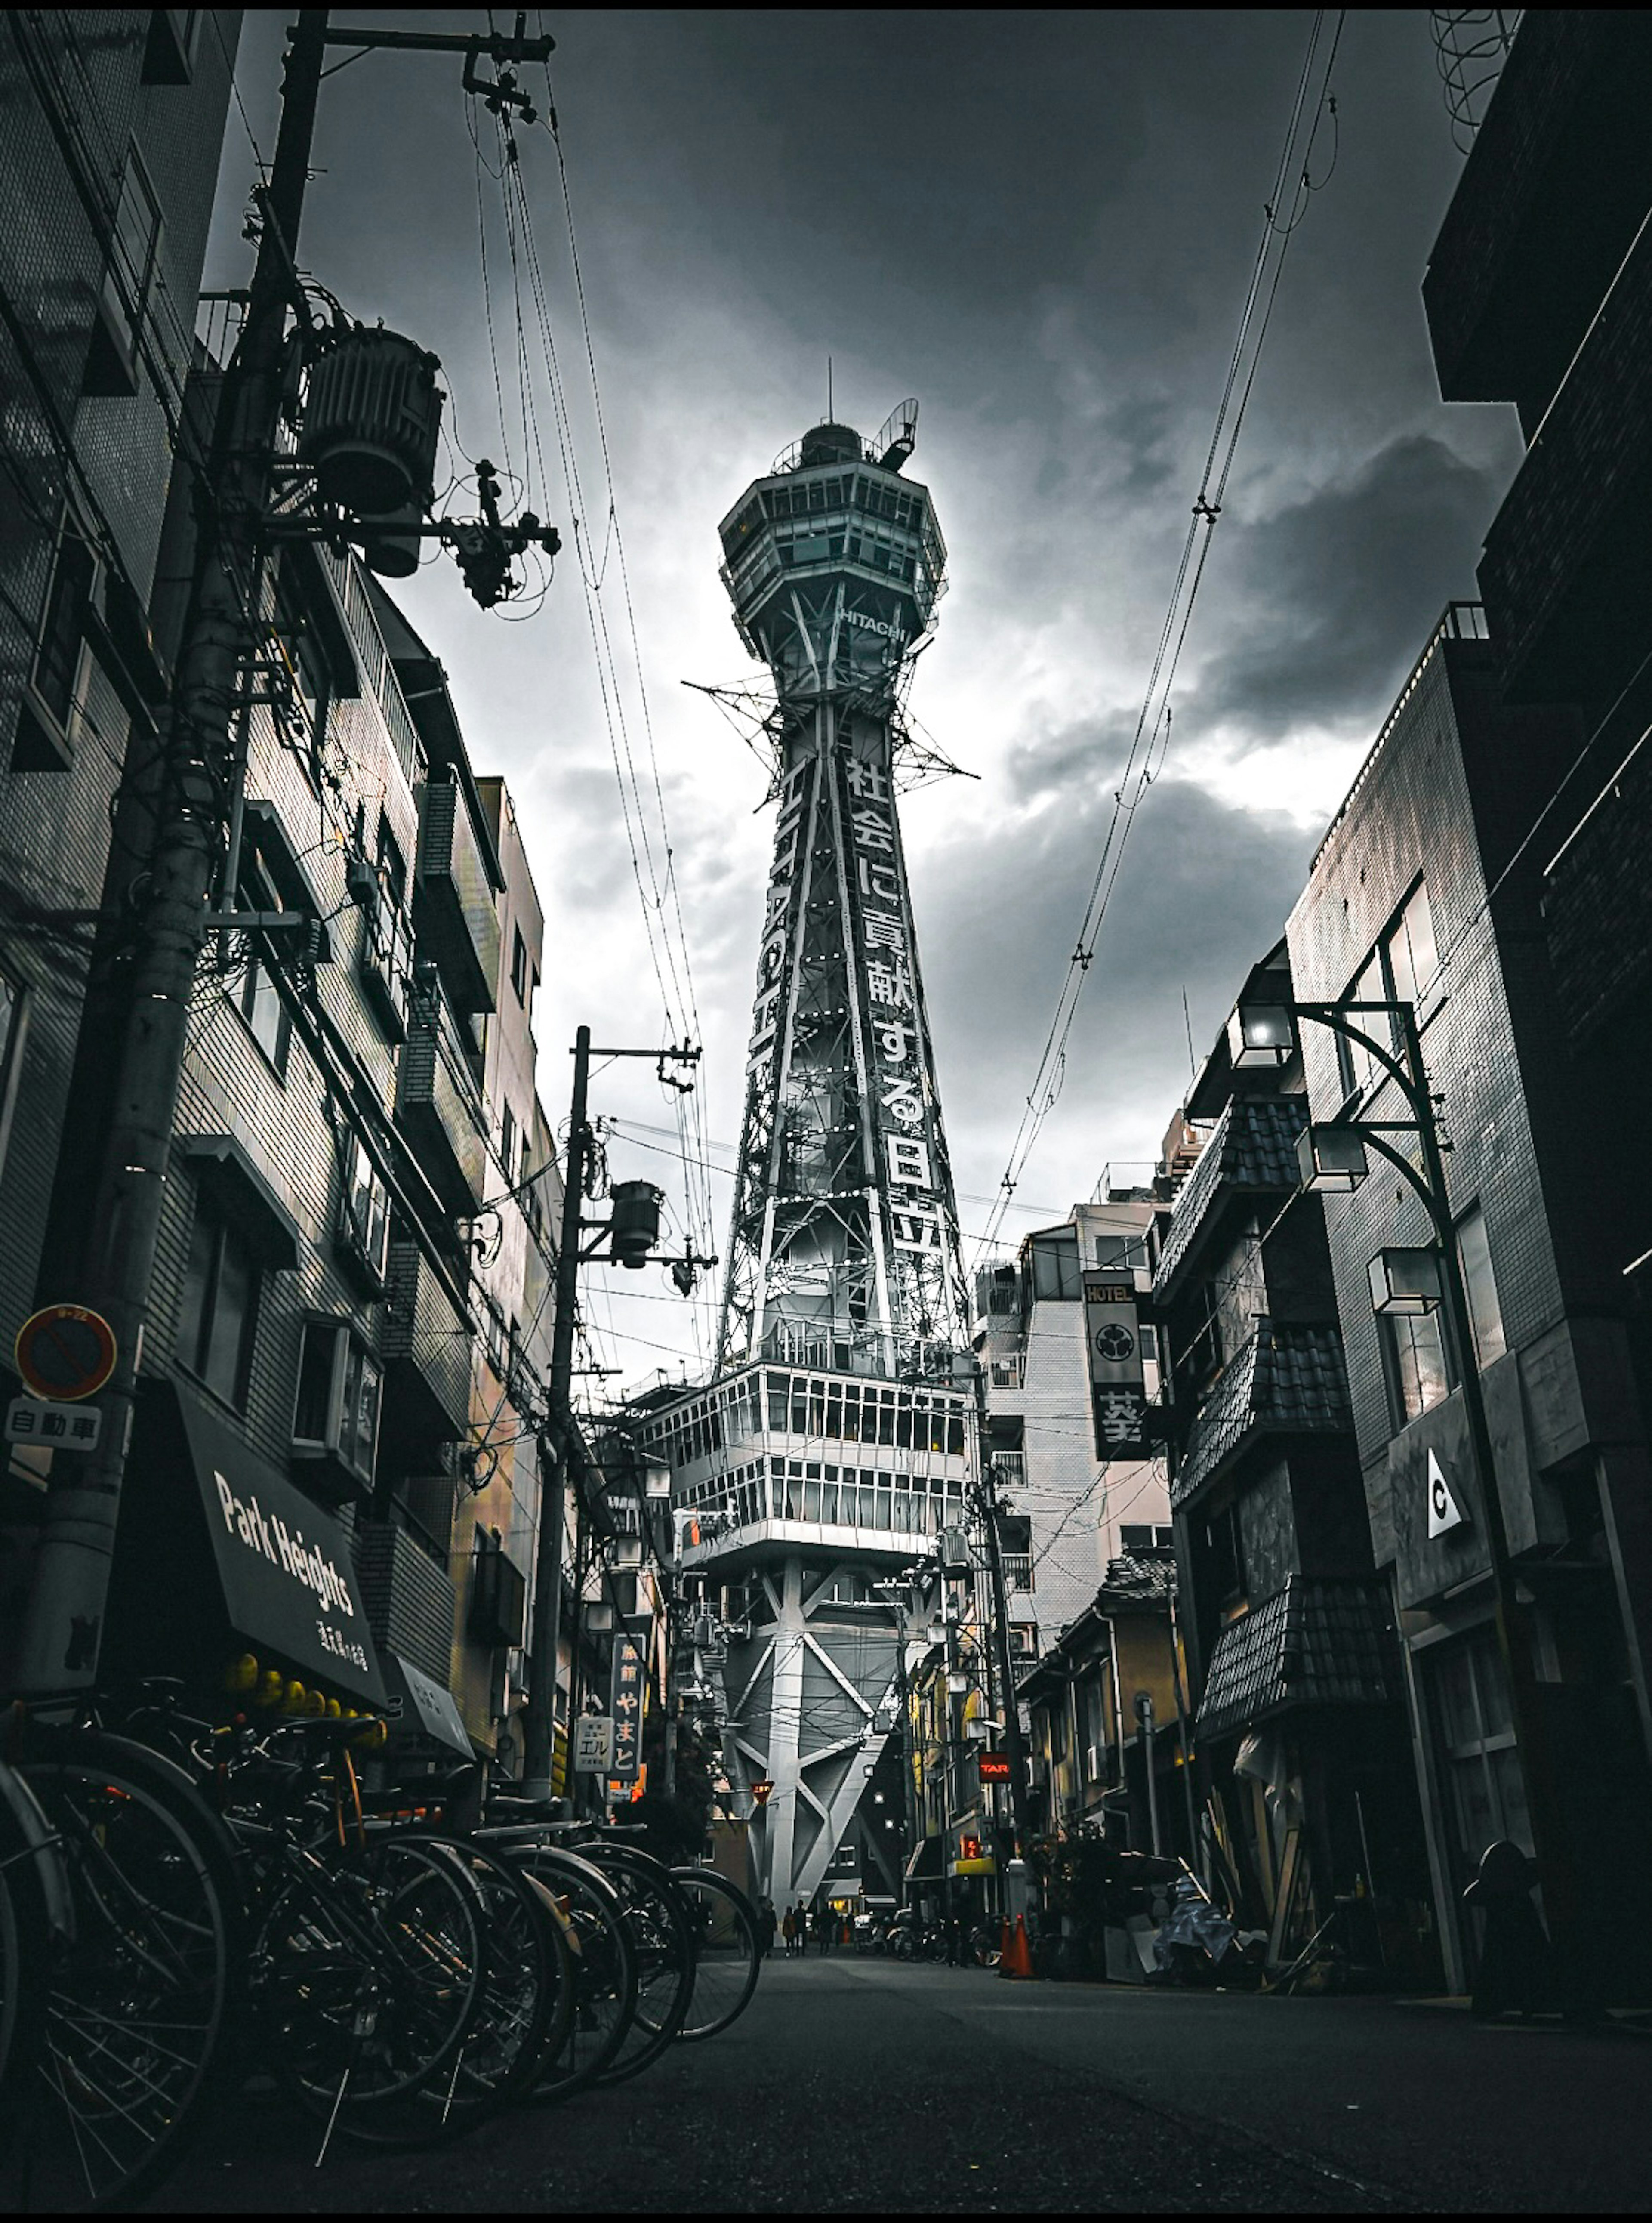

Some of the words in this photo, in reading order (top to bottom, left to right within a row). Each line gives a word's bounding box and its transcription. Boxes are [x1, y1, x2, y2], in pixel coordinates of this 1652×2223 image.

[840, 608, 906, 642] HITACHI
[746, 756, 807, 1075] HITACHI
[846, 758, 943, 1256] 社会に貢献する日立
[1087, 1285, 1133, 1302] HOTEL
[12, 1410, 96, 1440] 自動車
[1433, 1479, 1447, 1520] C
[213, 1470, 279, 1565] Park
[271, 1514, 354, 1617] Heights
[580, 1741, 609, 1755] エル
